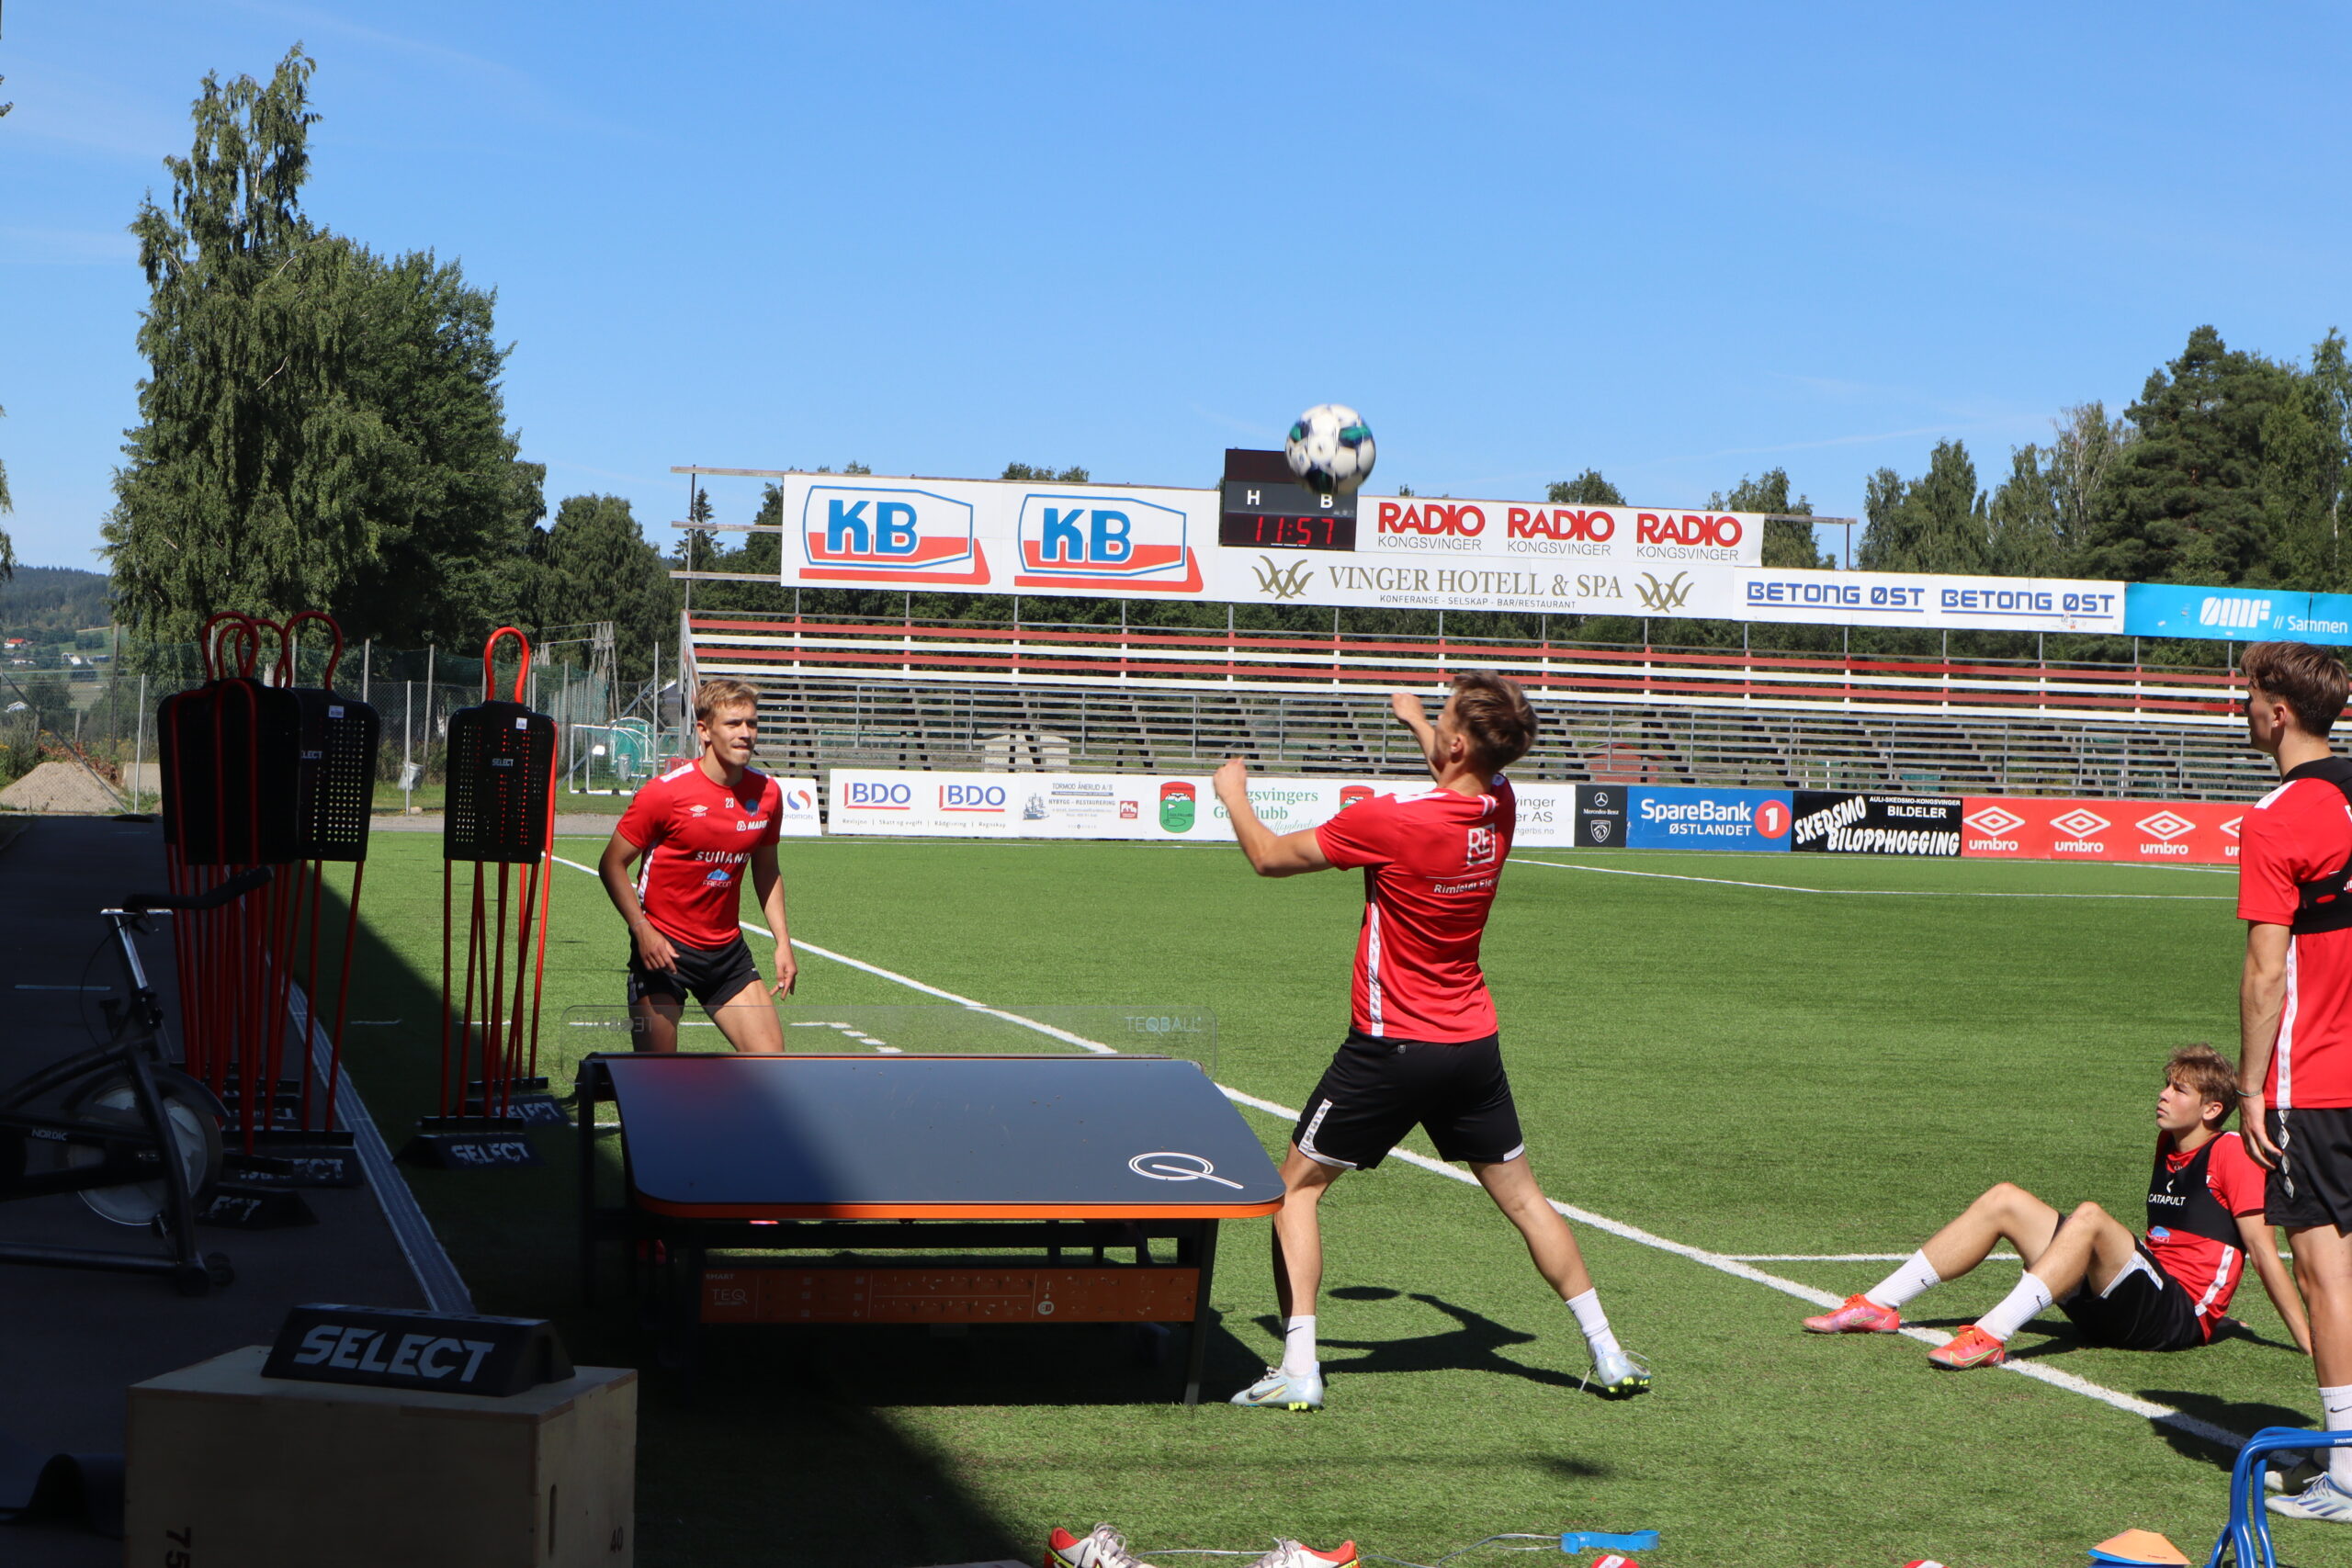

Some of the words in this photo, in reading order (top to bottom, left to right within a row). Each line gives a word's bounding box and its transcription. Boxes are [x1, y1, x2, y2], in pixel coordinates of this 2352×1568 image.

[1247, 490, 1261, 505] H
[1320, 493, 1333, 508] B
[828, 499, 918, 555] KB
[1378, 502, 1487, 537] RADIO
[1507, 507, 1615, 543] RADIO
[1043, 508, 1132, 562] KB
[1255, 516, 1335, 545] 11:57
[1636, 513, 1743, 548] RADIO
[1378, 536, 1482, 551] KONGSVINGER
[1508, 540, 1611, 556] KONGSVINGER
[1636, 546, 1739, 561] KONGSVINGER
[1329, 565, 1430, 592] VINGER
[1437, 569, 1544, 597] HOTELL
[1554, 573, 1567, 597] &
[1576, 573, 1623, 599] SPA
[1380, 594, 1440, 605] KONFERANSE
[1447, 596, 1488, 607] SELSKAP
[1497, 598, 1577, 610] BAR/RESTAURANT
[1747, 581, 1860, 605] BETONG
[1940, 589, 2052, 612] BETONG
[2288, 615, 2348, 634] Sammen
[492, 758, 514, 767] SELECT
[725, 797, 734, 808] 23
[852, 783, 911, 804] BDO
[947, 784, 1006, 807] BDO
[1869, 795, 1961, 807] AULI-SKEDSMO-KONGSVINGER
[1532, 812, 1554, 823] AS
[1640, 798, 1752, 823] SpareBank
[1793, 795, 1867, 844] SKEDSMO
[1887, 805, 1947, 818] BILDELER
[1668, 821, 1752, 837] ØSTLANDET
[1826, 827, 1960, 856] BILOPPHOGGING
[1968, 837, 2018, 852] umbro
[2054, 840, 2105, 854] umbro
[2140, 841, 2188, 855] umbro
[30, 1128, 69, 1142] NORDIC
[2148, 1193, 2187, 1206] CATAPULT
[293, 1324, 496, 1382] SELECT
